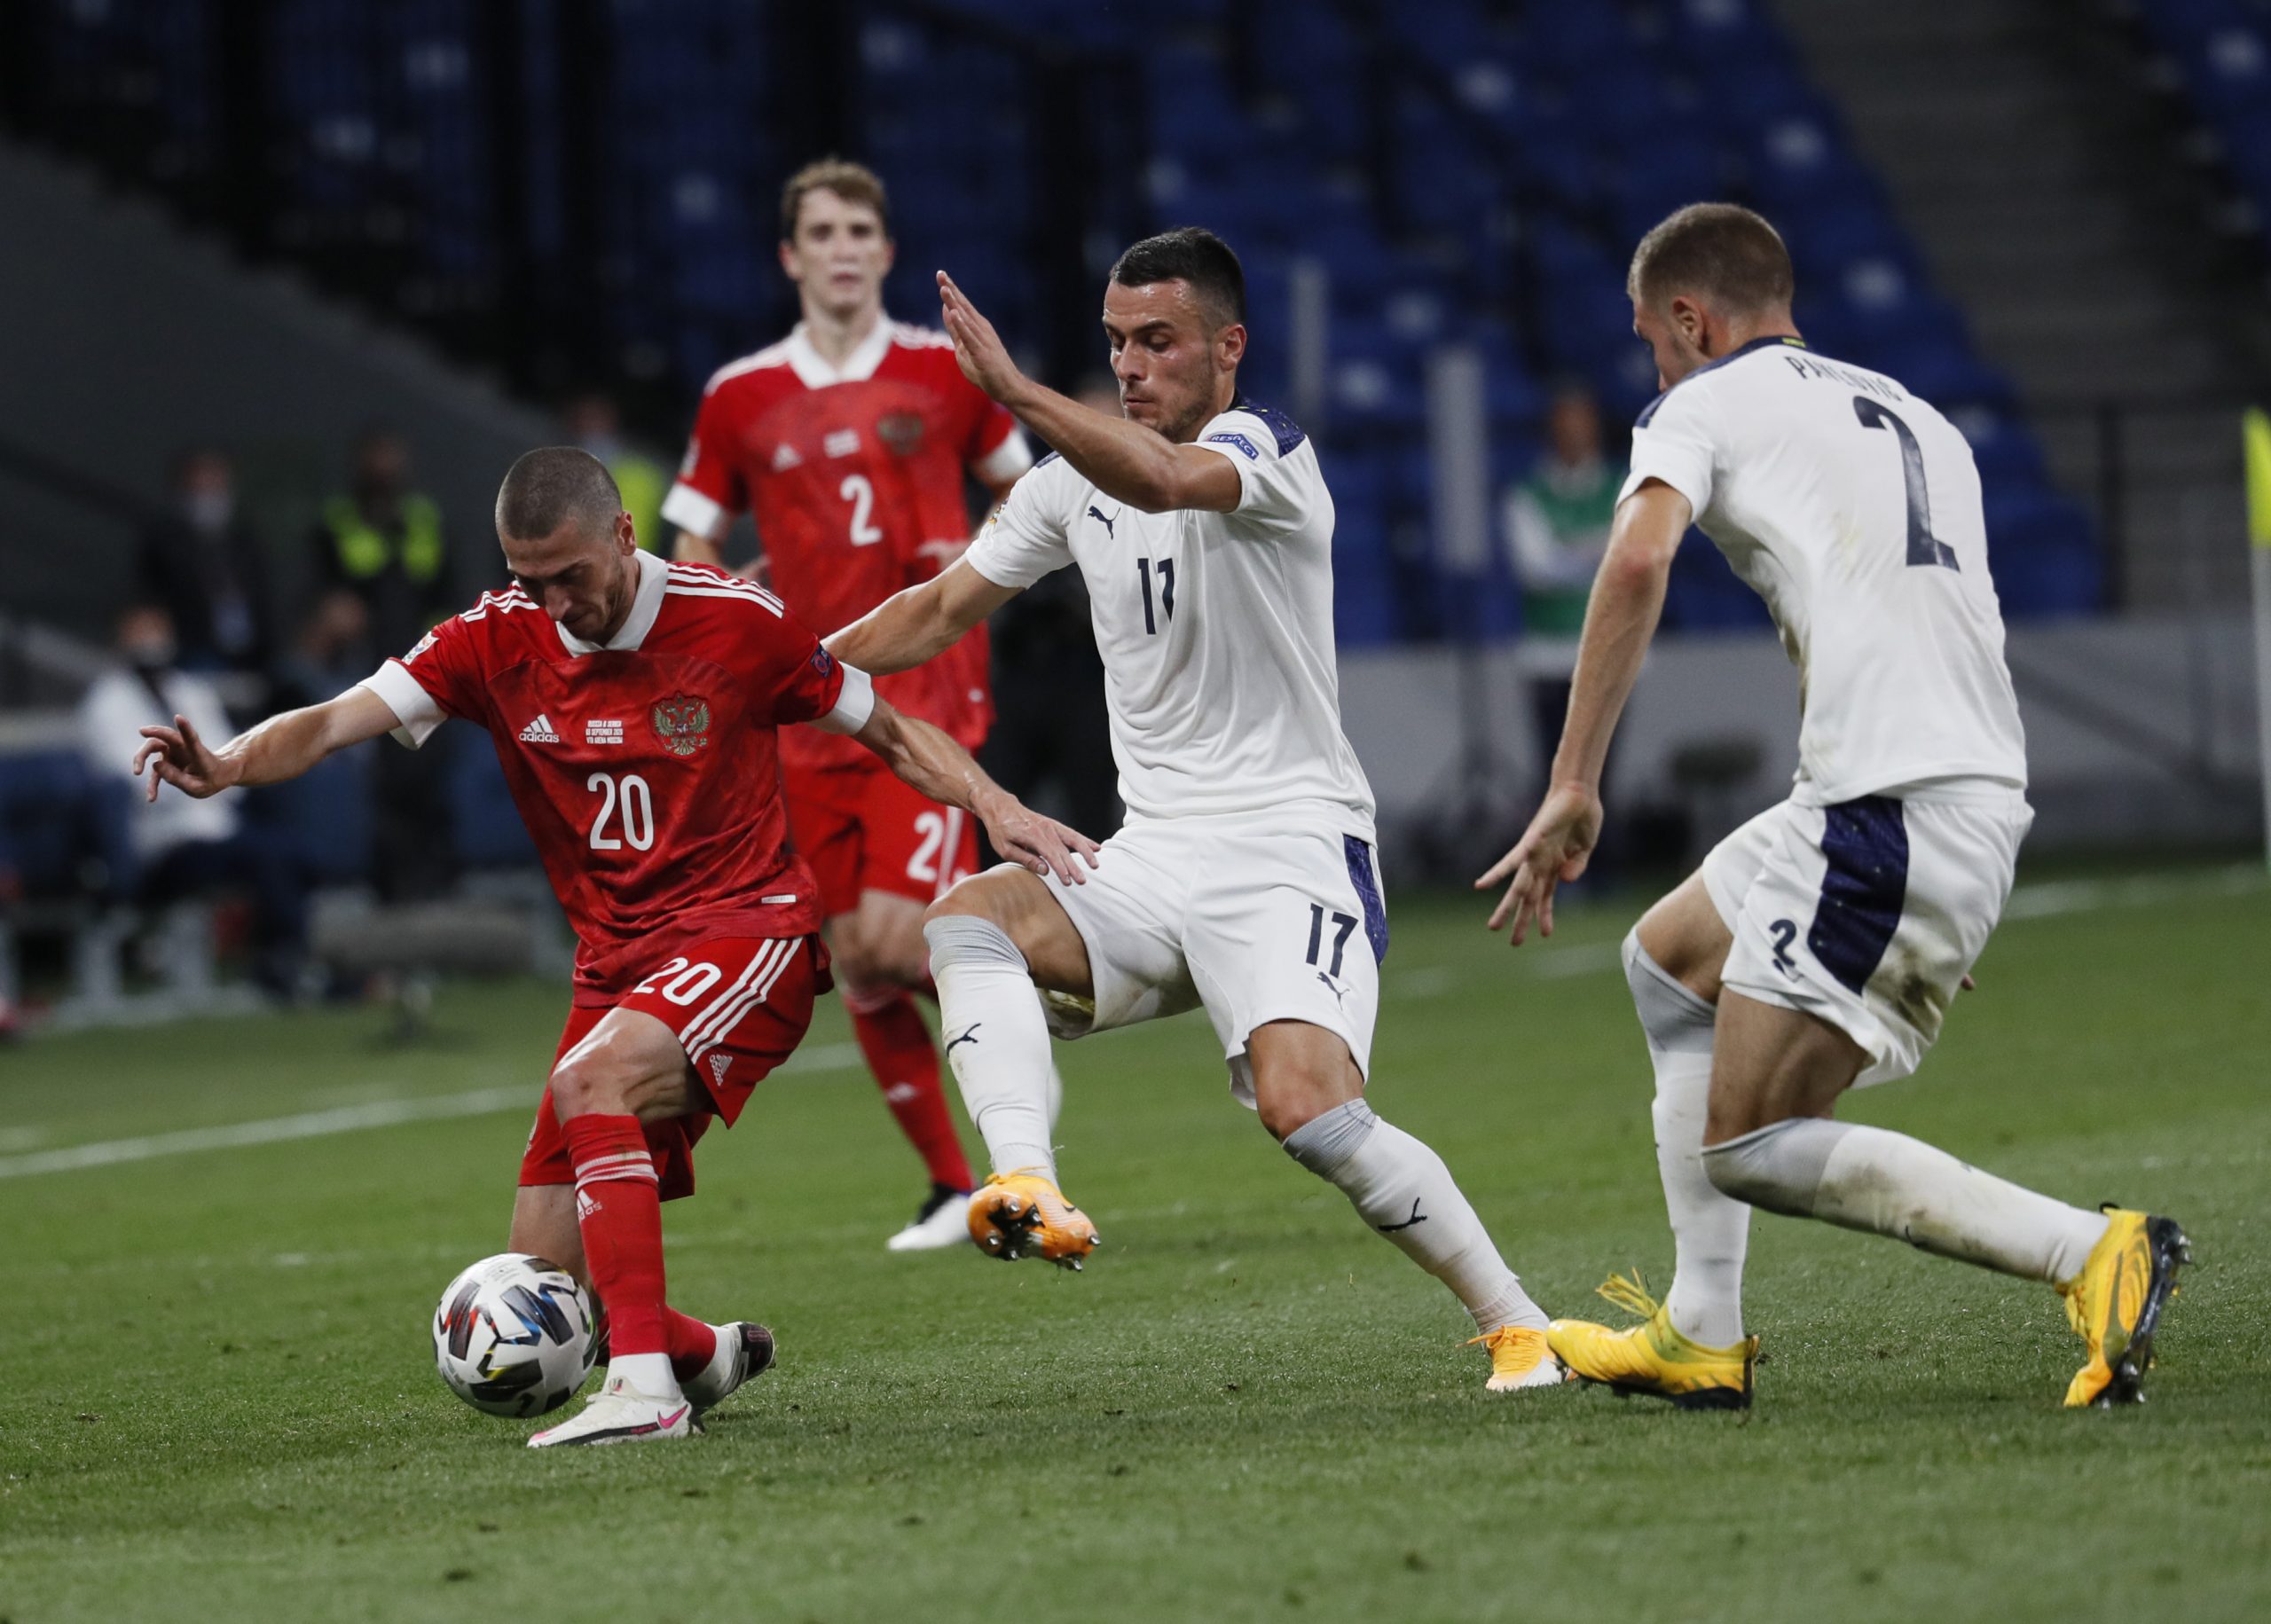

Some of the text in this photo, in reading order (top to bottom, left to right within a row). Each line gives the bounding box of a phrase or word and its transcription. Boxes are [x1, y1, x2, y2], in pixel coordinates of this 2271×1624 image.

[1211, 435, 1257, 458] RESPECT
[840, 475, 882, 547] 2
[1852, 395, 1961, 571] 2
[519, 732, 560, 743] adidas
[587, 773, 654, 851] 20
[906, 812, 944, 883] 2
[1306, 902, 1359, 978] 17
[1769, 919, 1797, 974] 2
[632, 956, 722, 1007] 20
